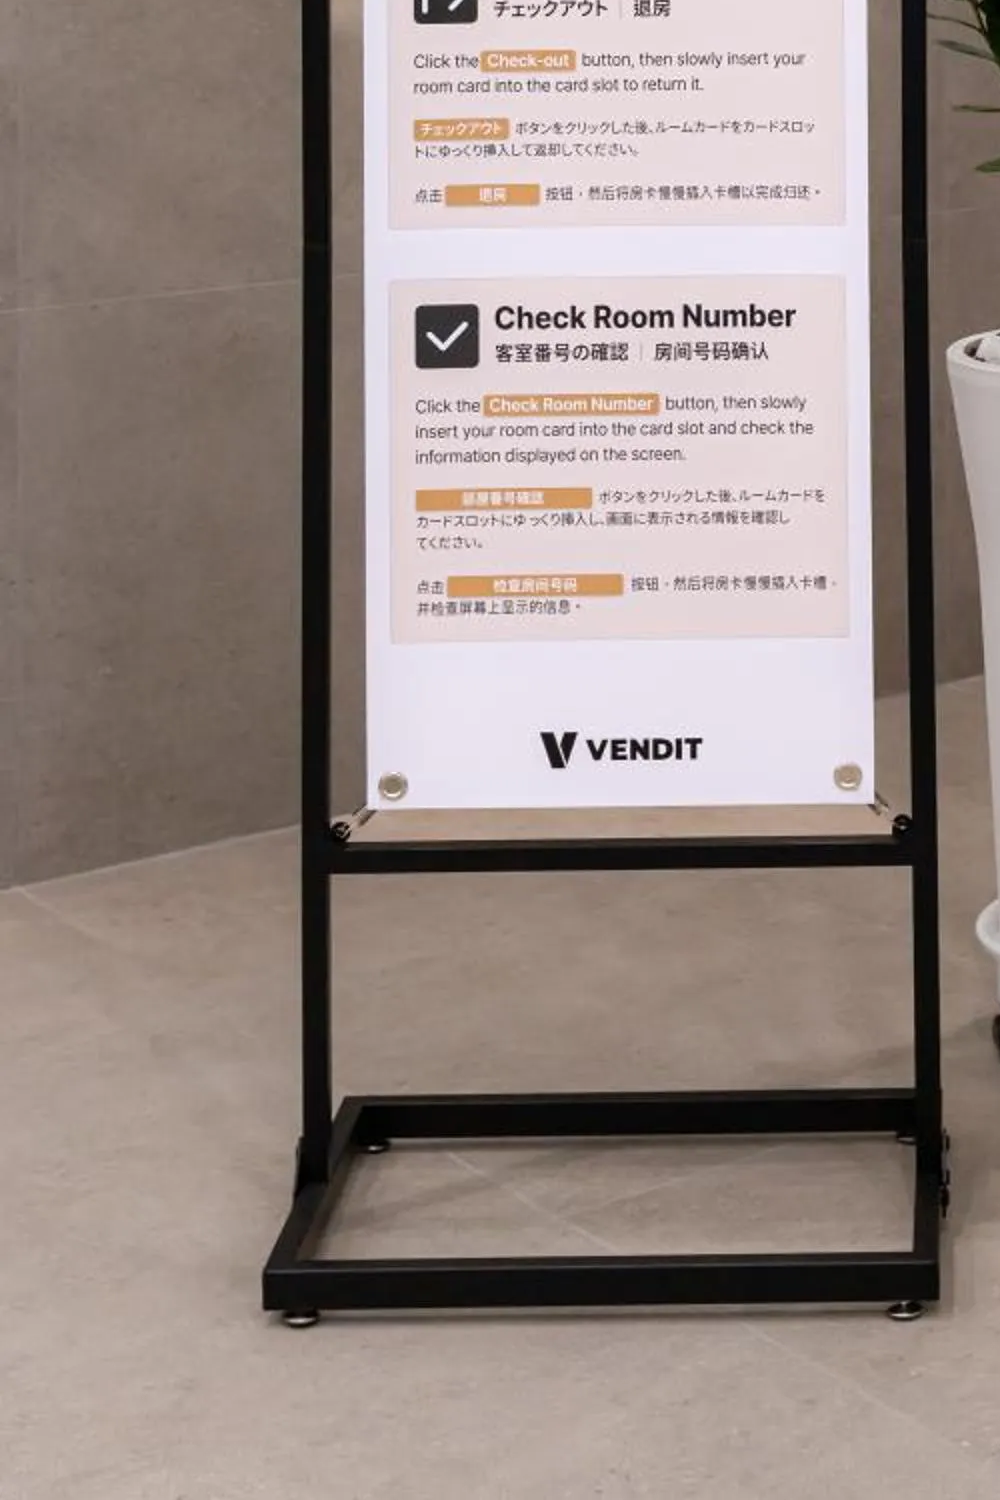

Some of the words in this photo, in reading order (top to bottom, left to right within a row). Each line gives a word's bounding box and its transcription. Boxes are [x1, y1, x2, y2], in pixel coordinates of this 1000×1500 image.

[493, 0, 608, 18] チェックアウト
[414, 54, 450, 69] Click
[455, 54, 479, 69] the
[487, 53, 569, 68] Check-out
[582, 53, 634, 69] button,
[639, 53, 672, 66] then
[677, 52, 722, 69] slowly
[727, 52, 768, 65] insert
[773, 54, 805, 69] your
[414, 82, 453, 93] room
[458, 79, 490, 93] card
[495, 79, 522, 93] into
[527, 79, 550, 92] the
[555, 78, 587, 92] card
[592, 78, 619, 92] slot
[624, 80, 638, 91] to
[642, 79, 686, 91] return
[691, 77, 704, 90] it.
[419, 123, 503, 136] チェックアウト
[415, 189, 442, 203] 点击
[479, 188, 507, 202] 退房
[495, 306, 586, 330] Check
[594, 305, 675, 329] Room
[683, 304, 796, 327] Number
[495, 343, 629, 363] 客室番号の確認
[654, 342, 769, 361] 房间号码确认
[416, 399, 451, 414] Click
[456, 399, 479, 413] the
[490, 398, 539, 413] Check
[543, 397, 587, 412] Room
[592, 397, 654, 411] Number
[665, 396, 718, 412] button,
[723, 395, 757, 409] then
[761, 395, 806, 412] slowly
[416, 424, 458, 438] insert
[463, 426, 494, 441] your
[500, 425, 538, 437] room
[542, 423, 575, 436] card
[579, 422, 607, 436] into
[612, 422, 635, 436] the
[640, 422, 672, 436] card
[677, 421, 704, 435] slot
[709, 421, 736, 435] and
[741, 421, 785, 435] check
[789, 421, 813, 435] the
[416, 450, 500, 464] information
[505, 449, 575, 466] displayed
[580, 451, 598, 462] on
[603, 448, 627, 462] the
[631, 449, 686, 462] screen.
[417, 536, 483, 550] てください。
[417, 581, 444, 595] 点击
[586, 737, 703, 760] VENDIT
